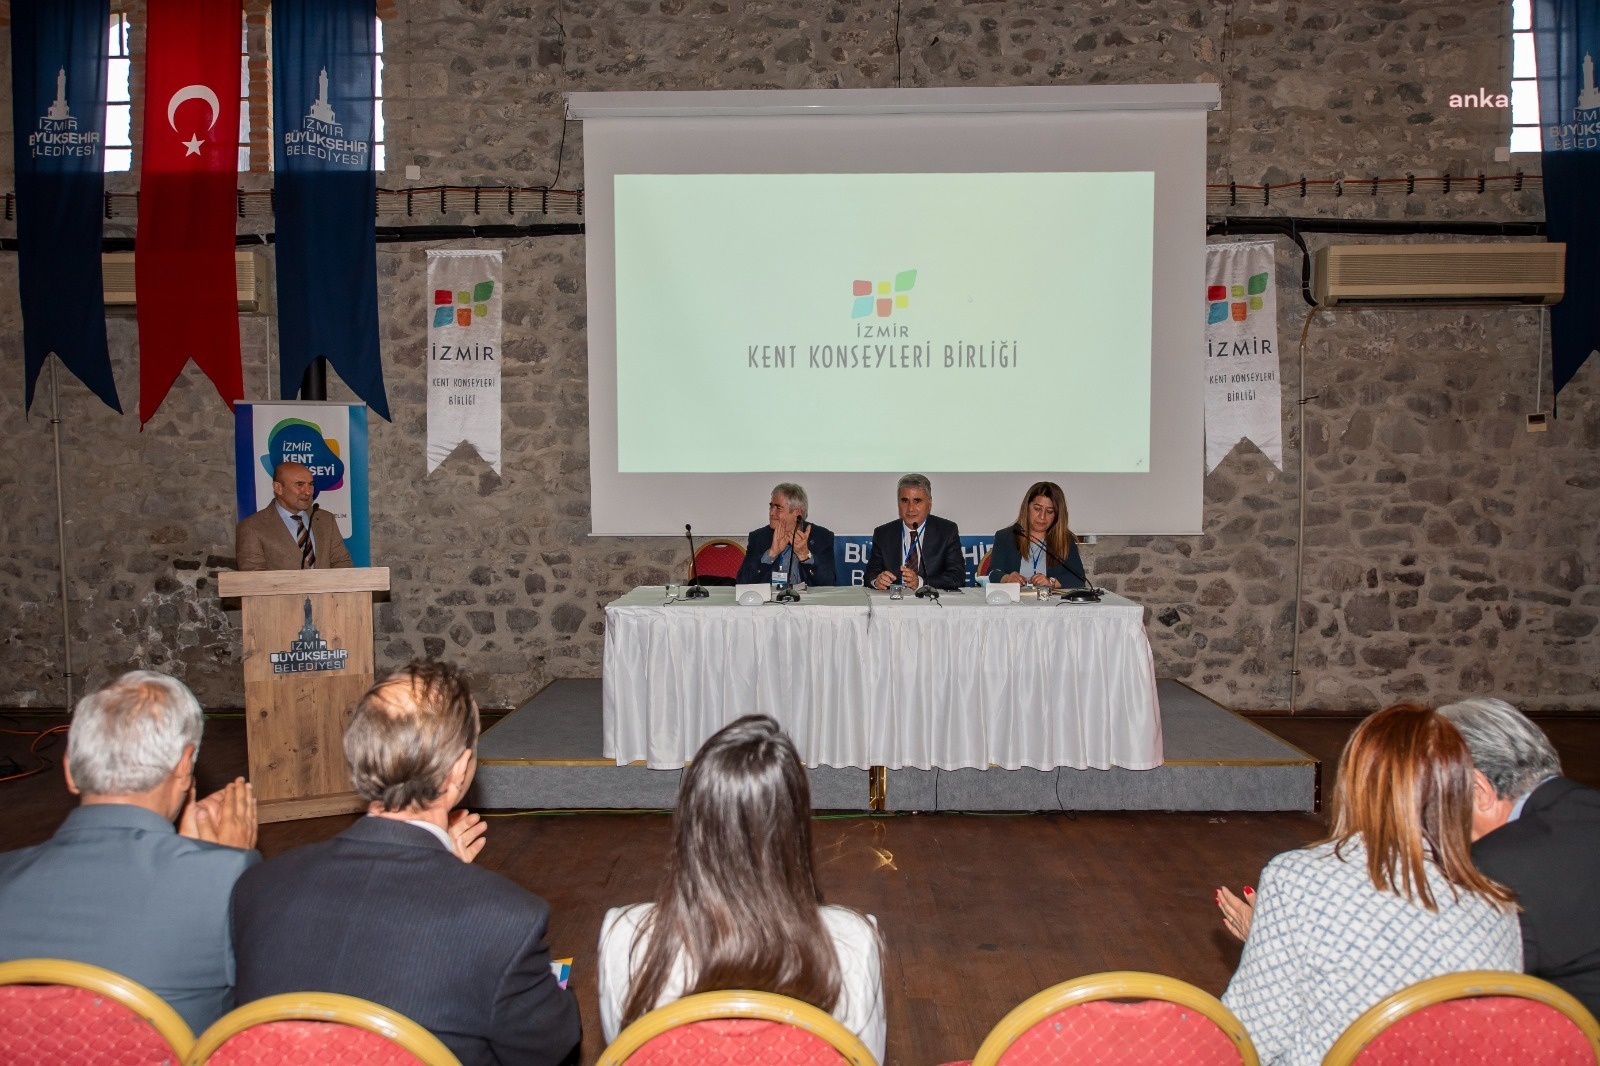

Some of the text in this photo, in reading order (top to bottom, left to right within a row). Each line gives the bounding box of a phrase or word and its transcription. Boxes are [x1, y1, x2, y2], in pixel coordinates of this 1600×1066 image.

[1573, 110, 1600, 121] İZM
[39, 118, 78, 131] İZMİR
[303, 117, 344, 137] İZMİR
[29, 130, 100, 146] BYÜKŞEHİR
[1555, 137, 1600, 151] BELED
[286, 144, 364, 165] BELEDİYESİ
[857, 322, 909, 338] İZMİR
[432, 342, 494, 361] İZMİR
[1208, 336, 1272, 358] İZMİR
[749, 340, 1018, 369] KENT KONSEYLERİ BİRLİĞİ
[432, 378, 495, 388] KENT KONSEYLERİ
[1209, 370, 1275, 384] KENT KONSEYLERİ
[448, 394, 476, 406] BİRLİĞİ
[1227, 389, 1256, 402] BİRLİĞİ
[282, 440, 312, 452] İZMİR
[282, 453, 314, 464] KENT
[309, 463, 335, 476] SEYİ
[291, 640, 327, 651] İZMİR
[274, 659, 345, 673] BELEDİYESİ
